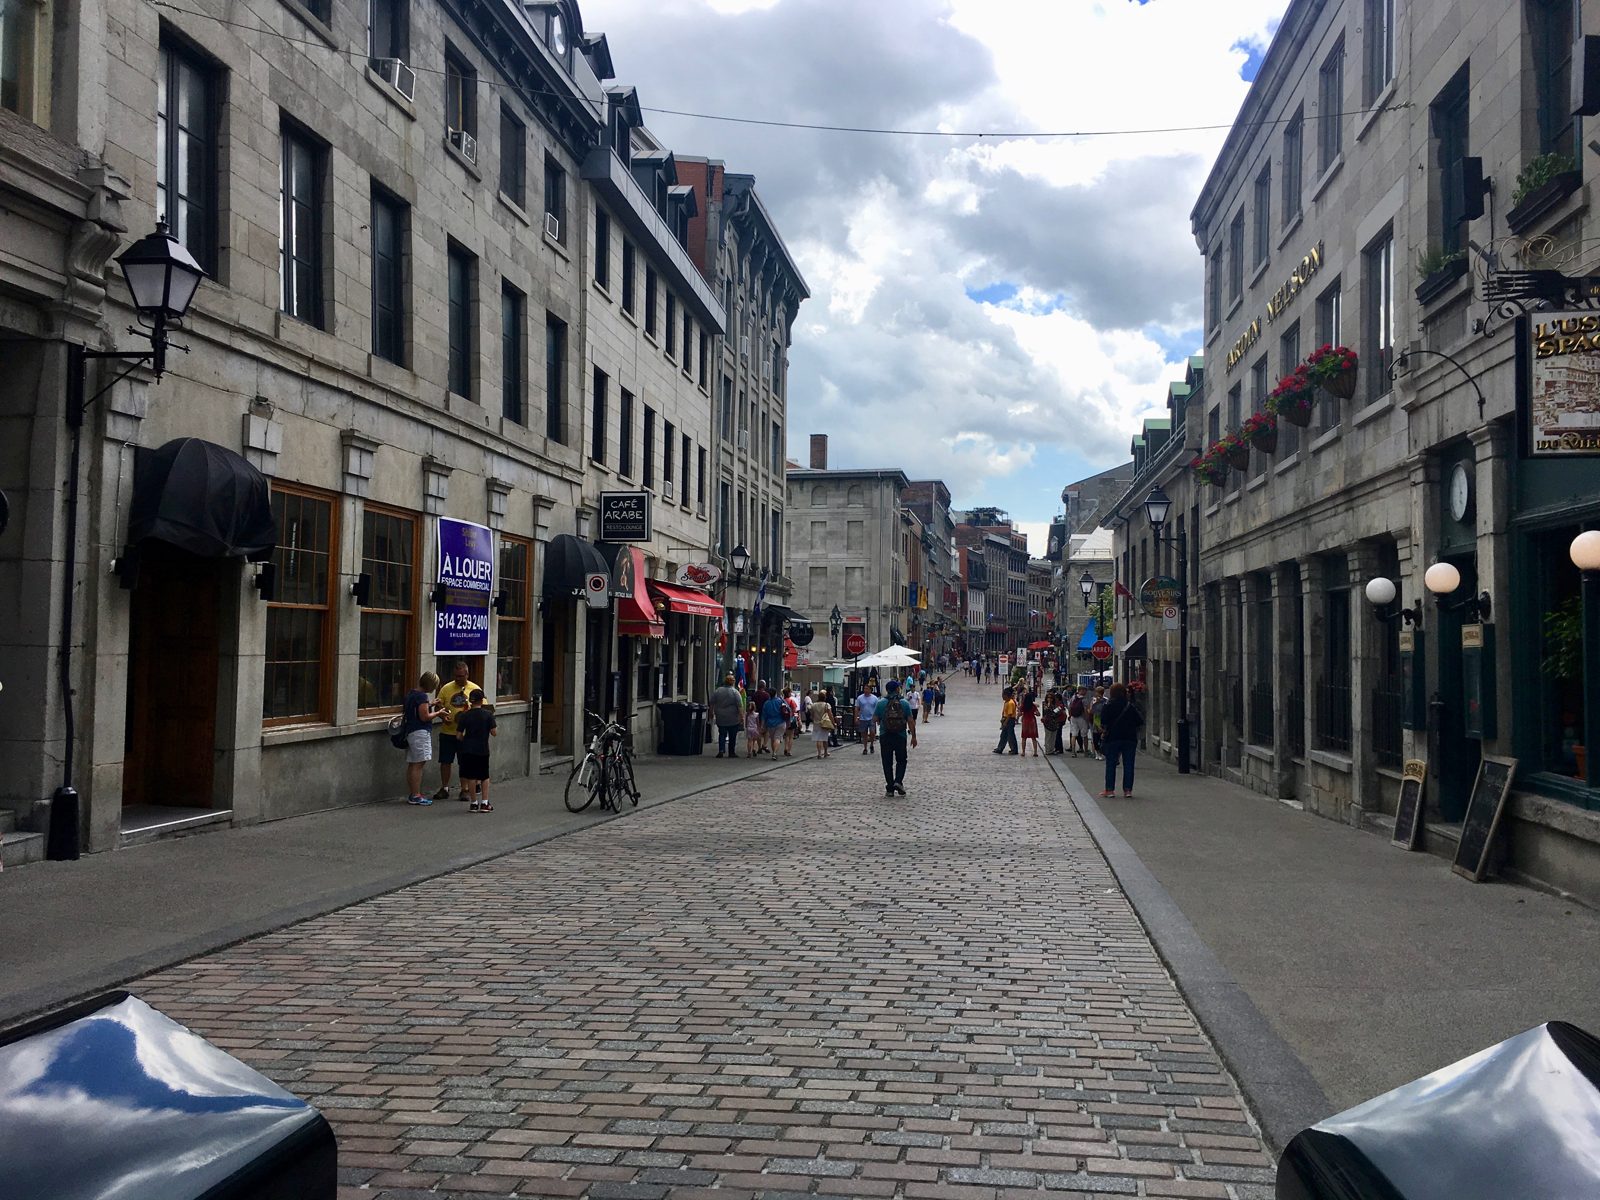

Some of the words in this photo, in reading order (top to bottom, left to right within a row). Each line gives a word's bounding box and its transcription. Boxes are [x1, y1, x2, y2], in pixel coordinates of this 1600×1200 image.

[1266, 239, 1322, 325] NELSON
[1536, 315, 1600, 341] L'US
[610, 499, 638, 509] CAFÉ
[604, 510, 643, 520] ARABE
[442, 552, 453, 576] À
[455, 556, 491, 581] LOUER
[441, 576, 463, 587] ESPACE
[438, 612, 455, 629] 514
[456, 613, 472, 630] 259
[472, 614, 488, 630] 2400
